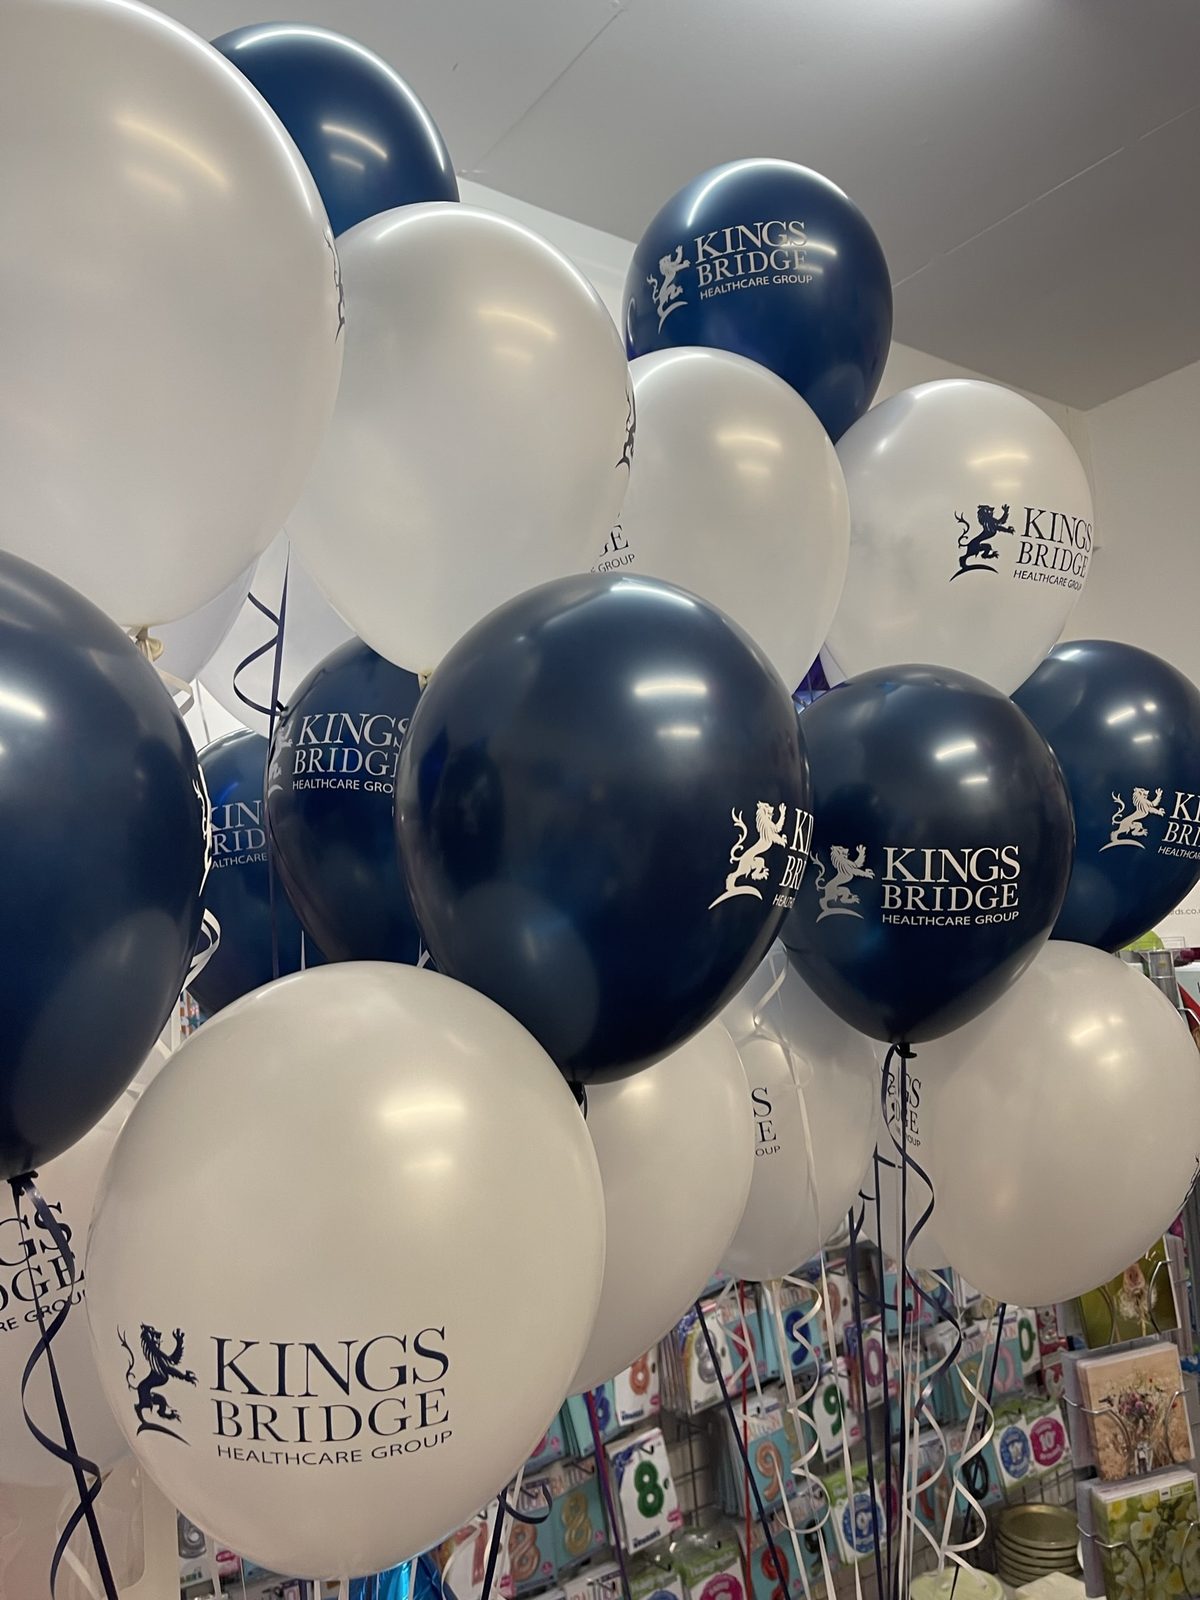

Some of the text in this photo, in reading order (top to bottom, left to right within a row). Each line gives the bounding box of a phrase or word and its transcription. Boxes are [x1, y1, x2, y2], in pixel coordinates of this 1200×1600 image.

[693, 220, 808, 265] KINGS
[696, 249, 808, 288] BRIDGE
[700, 274, 813, 300] HEALTHCARE GROUP
[1020, 506, 1093, 553] KINGS
[1016, 541, 1089, 579] BRIDGE
[1013, 569, 1068, 588] HEALTHCARE
[292, 747, 400, 778] BRIDG
[292, 778, 394, 794] HEALTHCARE GRO
[212, 828, 267, 856] RID
[1157, 845, 1200, 860] HEALTHCAR
[211, 852, 268, 870] ALTHCARE
[779, 855, 807, 891] BRI
[881, 845, 1021, 884] KINGS
[880, 882, 1020, 912] BRIDGE
[882, 911, 1020, 926] HEALTHCARE GROUP
[755, 1145, 781, 1158] OUP
[209, 1325, 450, 1398] KINGS
[210, 1387, 450, 1443] BRIDGE
[823, 1384, 846, 1437] 9
[217, 1430, 453, 1466] HEALTHCARE GROUP
[634, 1460, 665, 1519] 8
[562, 1491, 592, 1556] 8
[509, 1523, 541, 1581] 8
